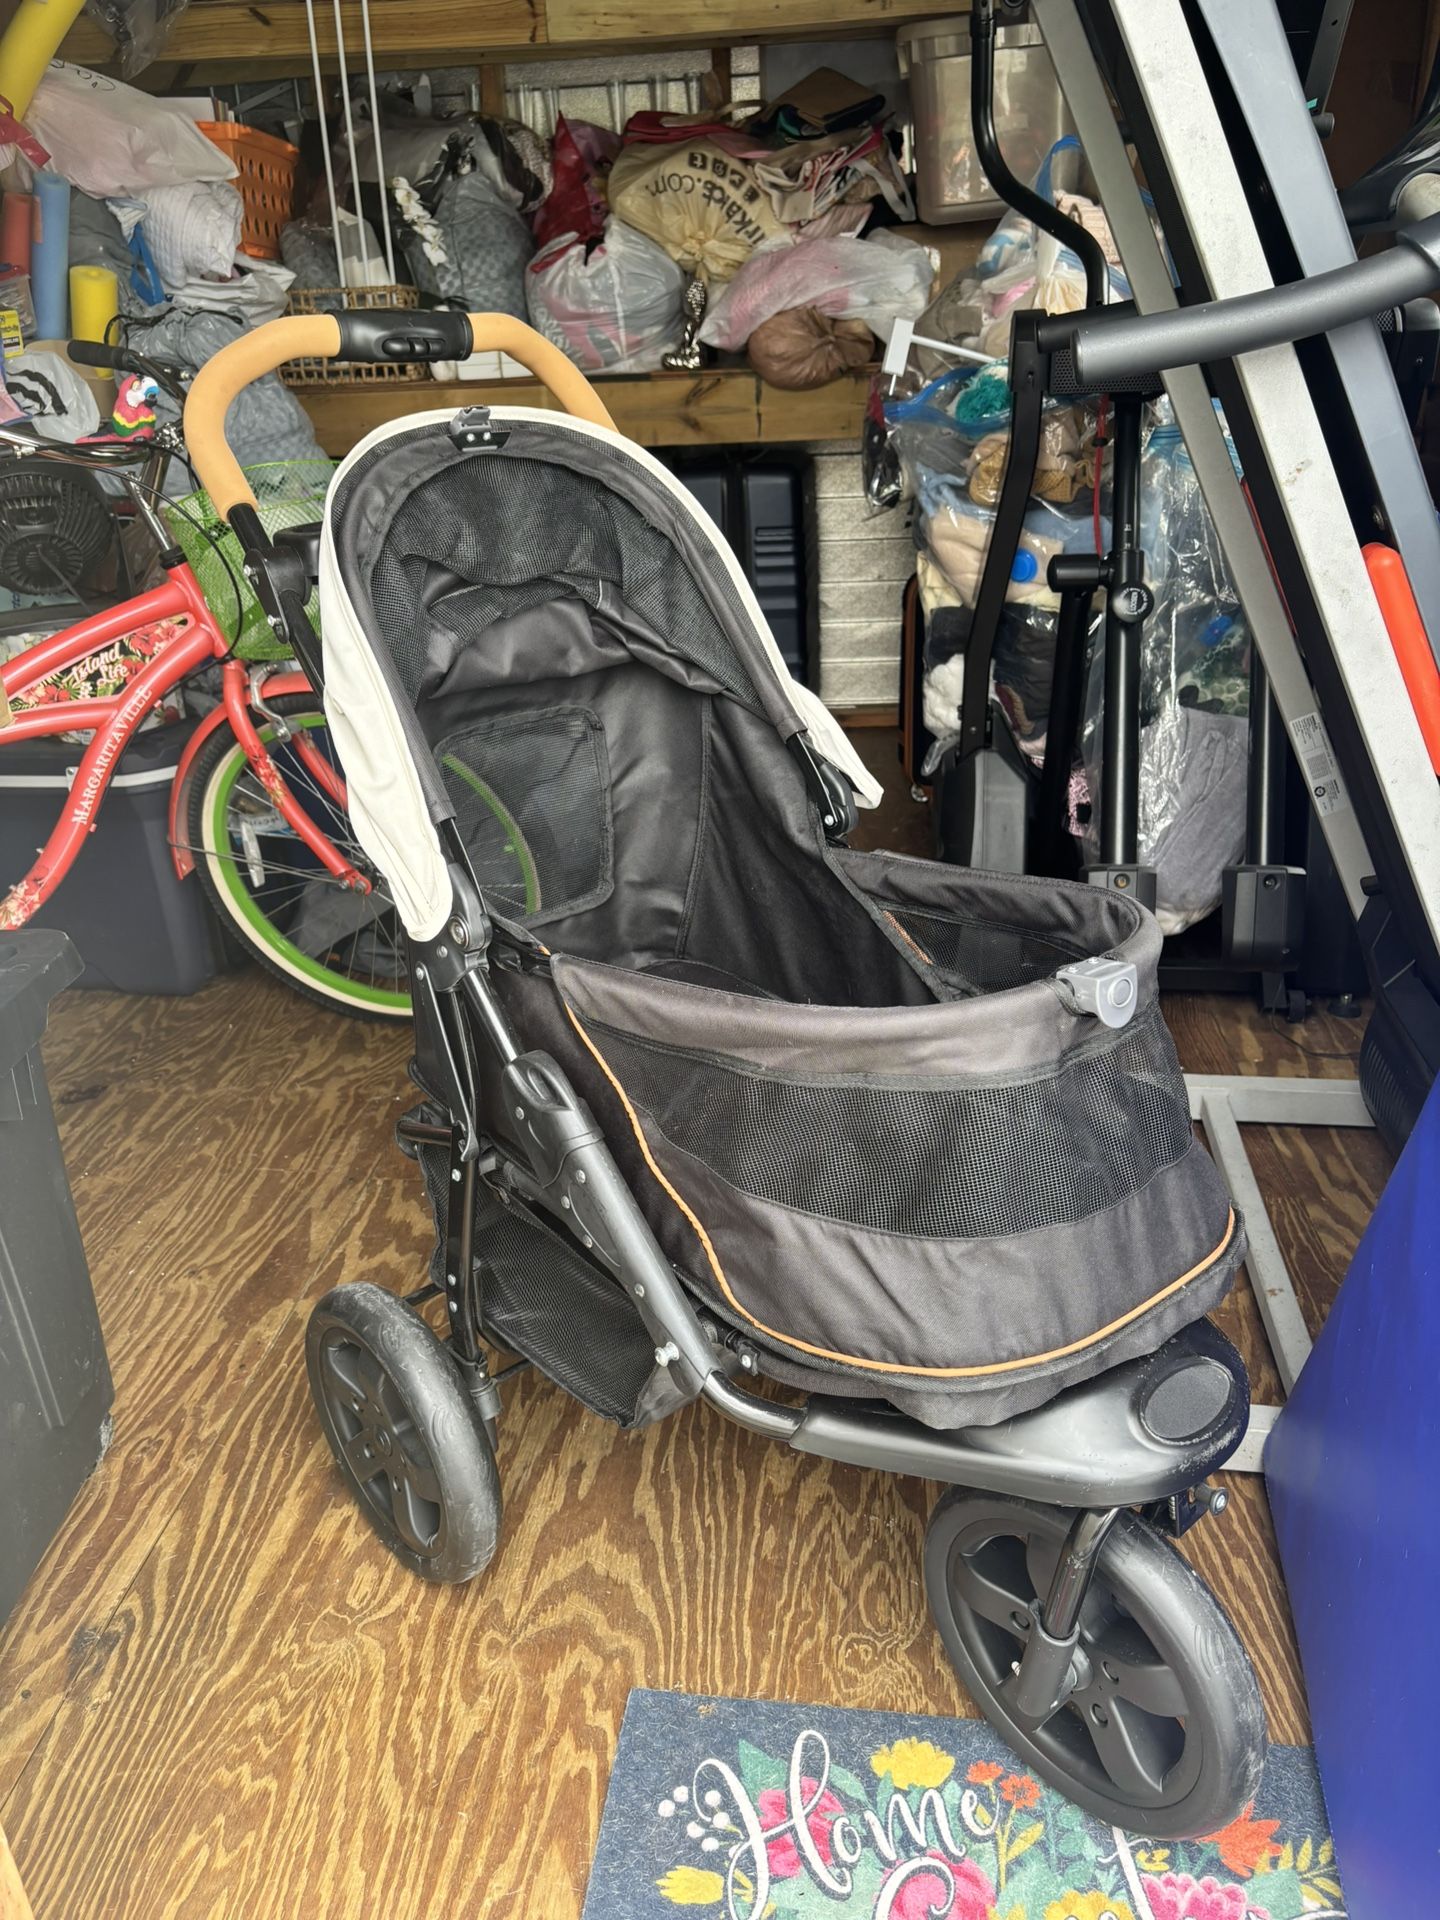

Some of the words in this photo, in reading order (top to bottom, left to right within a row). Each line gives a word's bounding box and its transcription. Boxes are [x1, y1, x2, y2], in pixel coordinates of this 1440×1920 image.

[62, 641, 125, 686] Island
[96, 662, 130, 686] Life
[72, 685, 152, 825] MARGARITAVILLE
[693, 1729, 1000, 1920] Home
